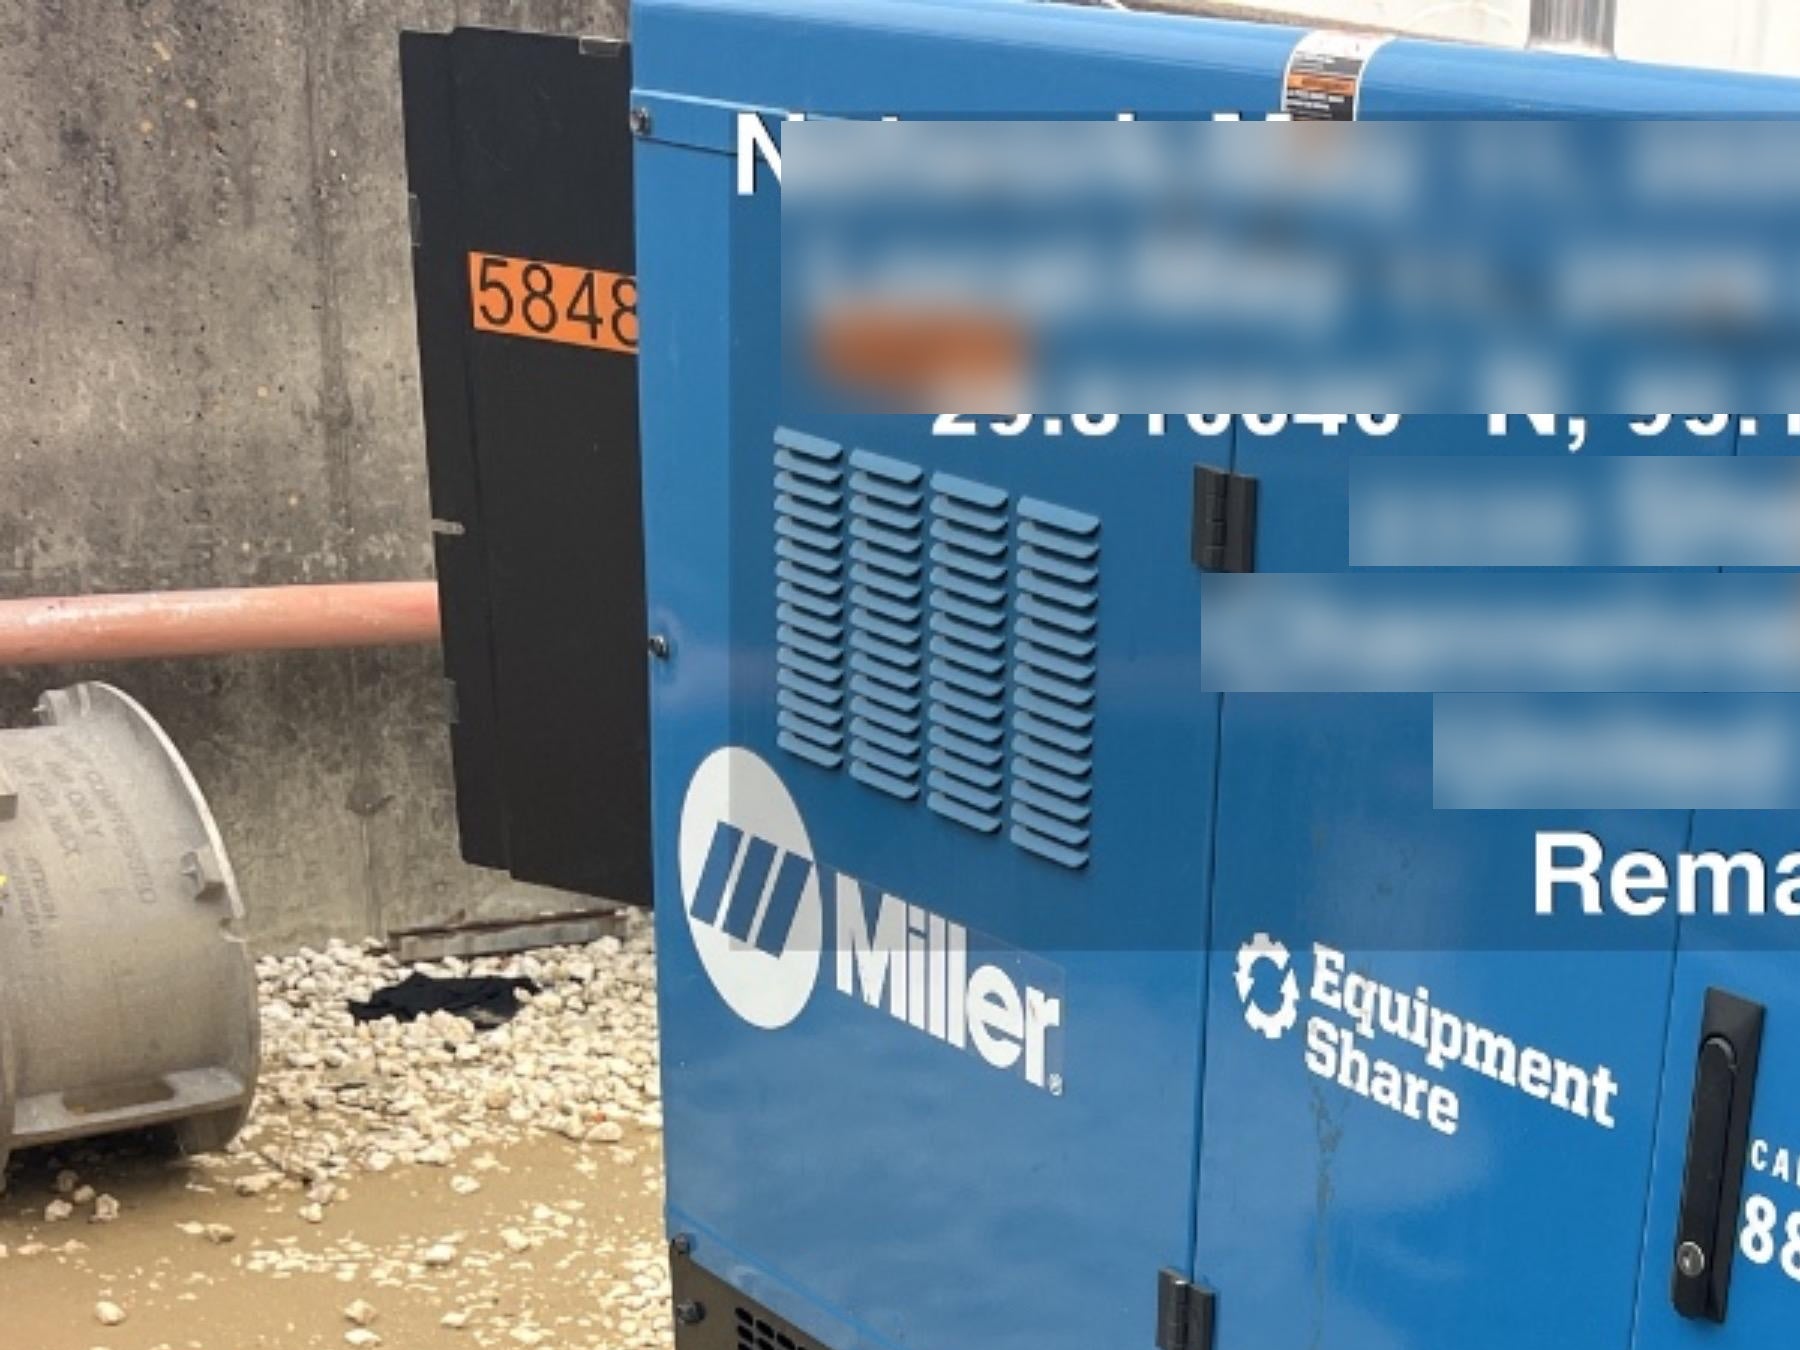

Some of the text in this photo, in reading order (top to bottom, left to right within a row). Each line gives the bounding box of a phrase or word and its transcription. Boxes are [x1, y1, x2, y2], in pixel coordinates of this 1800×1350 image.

[836, 872, 1060, 1088] Miller
[1311, 942, 1618, 1128] Equipment
[1305, 1016, 1459, 1135] Share
